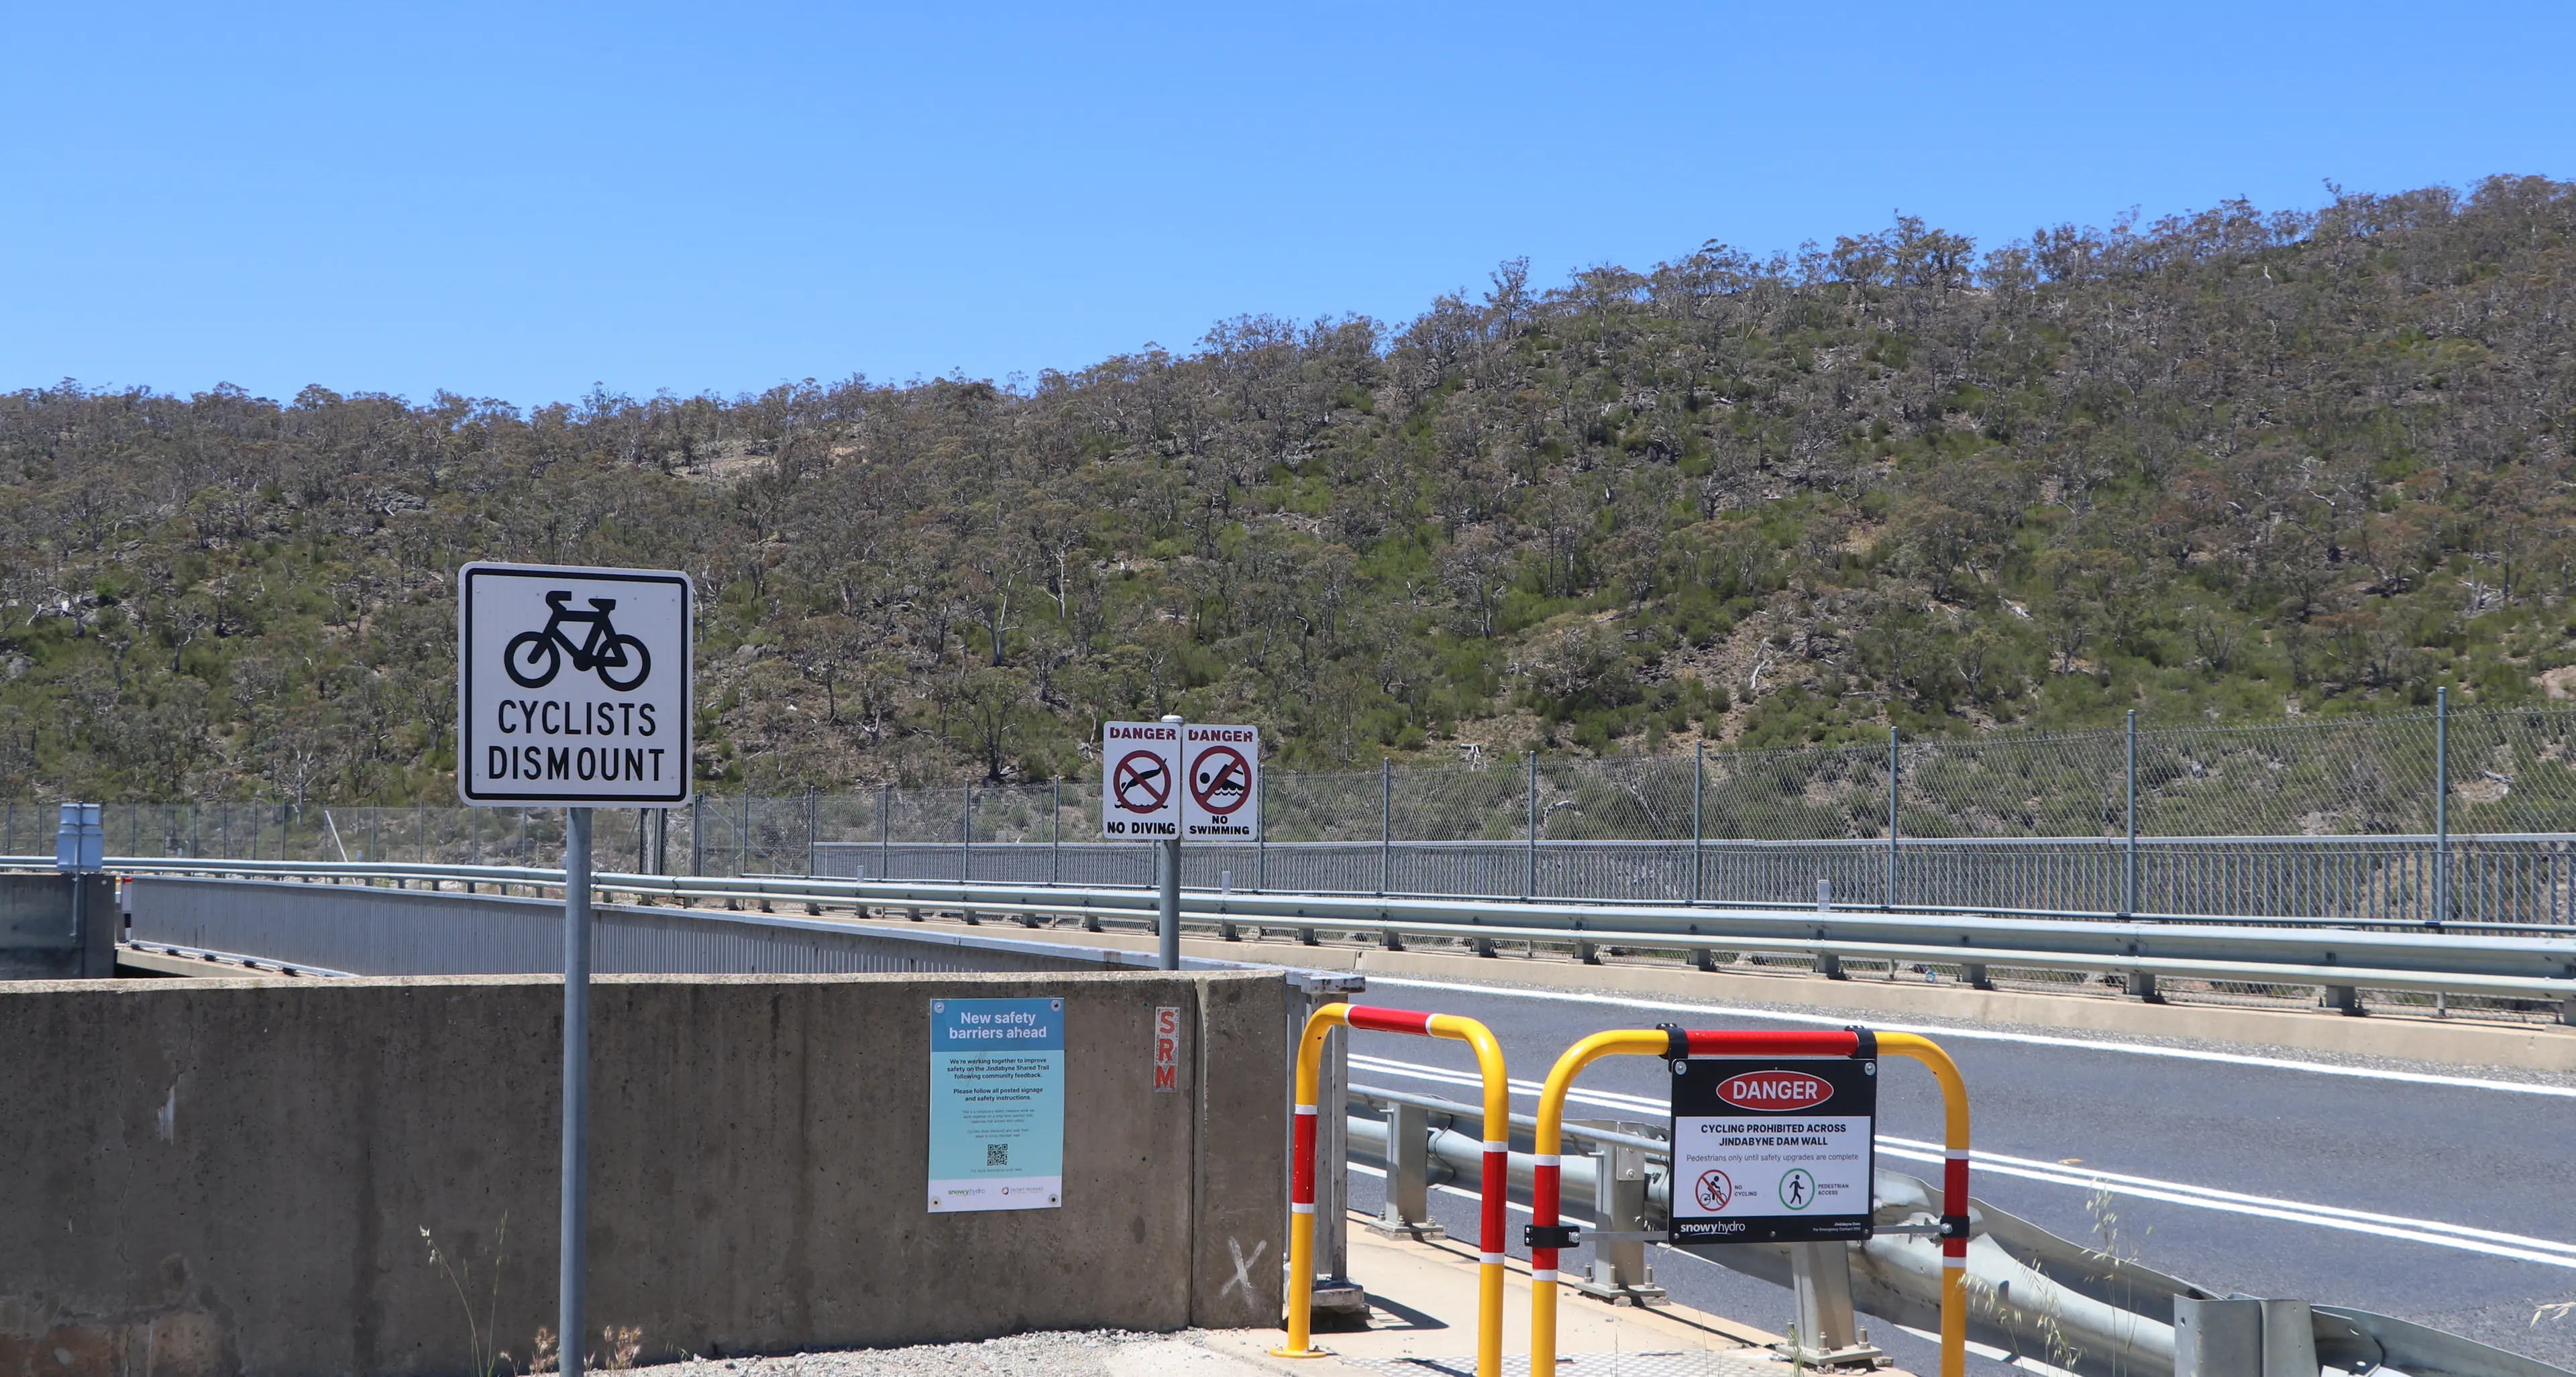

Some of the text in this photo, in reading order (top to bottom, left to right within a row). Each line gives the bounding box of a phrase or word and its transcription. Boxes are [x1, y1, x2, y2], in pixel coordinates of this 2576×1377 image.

[498, 700, 655, 736] CYCLISTS
[1110, 727, 1176, 740] DANGER
[1188, 729, 1253, 742] DANGER
[488, 746, 664, 781] DISMOUNT
[1212, 816, 1228, 824] NO
[1107, 822, 1175, 834] NO DIVING
[1189, 826, 1250, 835] SWIMMING
[961, 1011, 1036, 1026] New safety
[949, 1026, 1046, 1039] barriers ahead
[1733, 1081, 1818, 1100] DANGER
[1701, 1123, 1846, 1134] CYCLING PROHIBITED ACROSS
[1719, 1136, 1828, 1147] JINDABYNE DAM WALL
[1728, 1154, 1743, 1163] only
[1744, 1154, 1759, 1162] until
[1760, 1154, 1781, 1162] safety
[1783, 1154, 1815, 1162] upgrades
[1827, 1153, 1859, 1162] complete
[1680, 1221, 1746, 1234] snowyhydro
